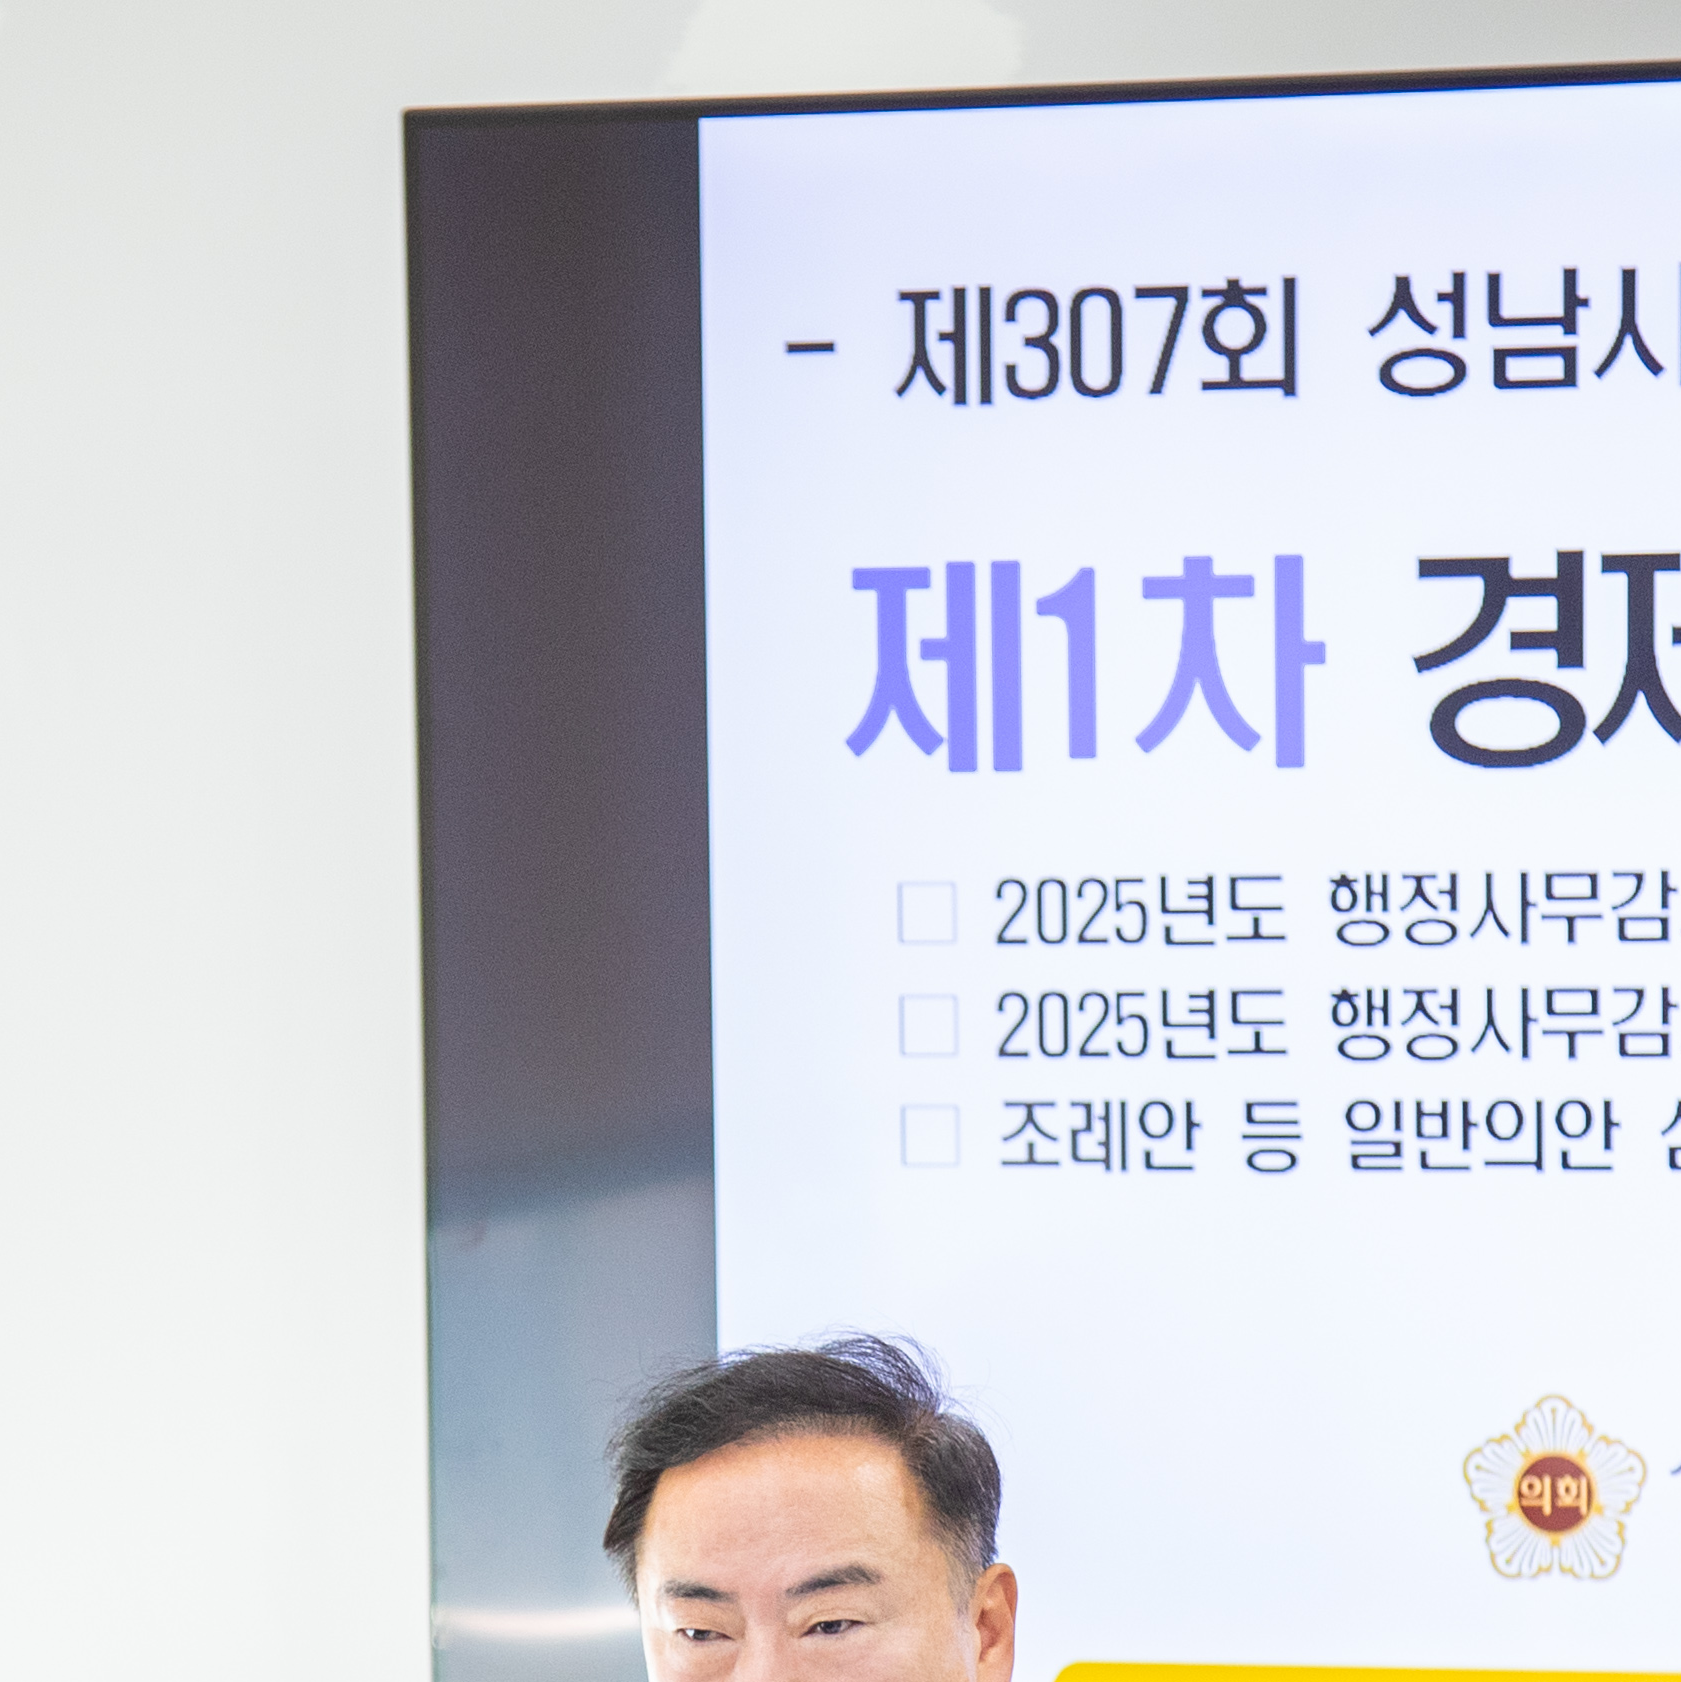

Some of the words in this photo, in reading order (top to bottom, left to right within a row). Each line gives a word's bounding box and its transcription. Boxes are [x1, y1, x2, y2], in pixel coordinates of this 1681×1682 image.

[895, 276, 1298, 407] 제307회
[845, 554, 1327, 774] 제1차
[995, 875, 1287, 946] 2025년도
[997, 989, 1288, 1060] 2025년도
[1001, 1100, 1202, 1172] 조례안
[1241, 1101, 1303, 1174] 등
[1344, 1099, 1621, 1172] 일반의안
[1519, 1473, 1591, 1517] 의회
